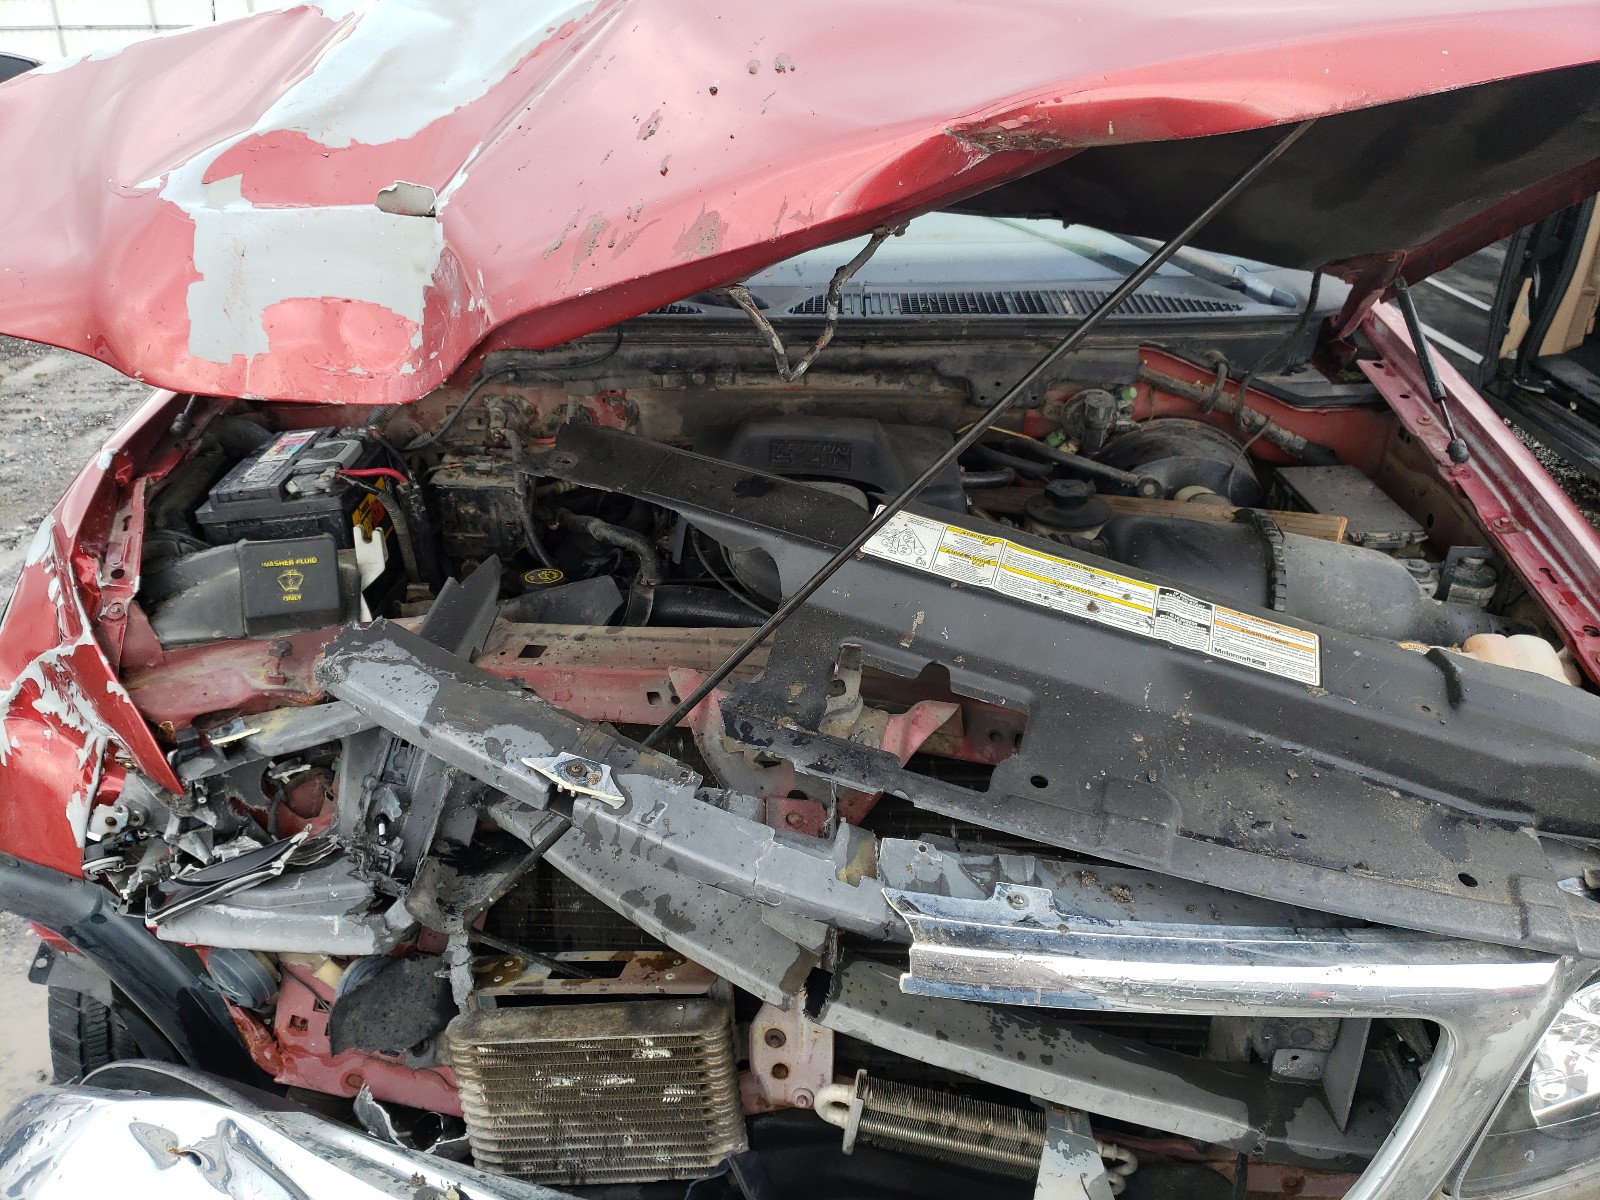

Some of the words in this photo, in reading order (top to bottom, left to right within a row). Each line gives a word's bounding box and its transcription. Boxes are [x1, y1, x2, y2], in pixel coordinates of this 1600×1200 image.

[261, 559, 294, 568] WASHER
[296, 557, 318, 565] FLUID
[283, 594, 302, 602] ONLY
[1214, 647, 1251, 663] Motorcraft
